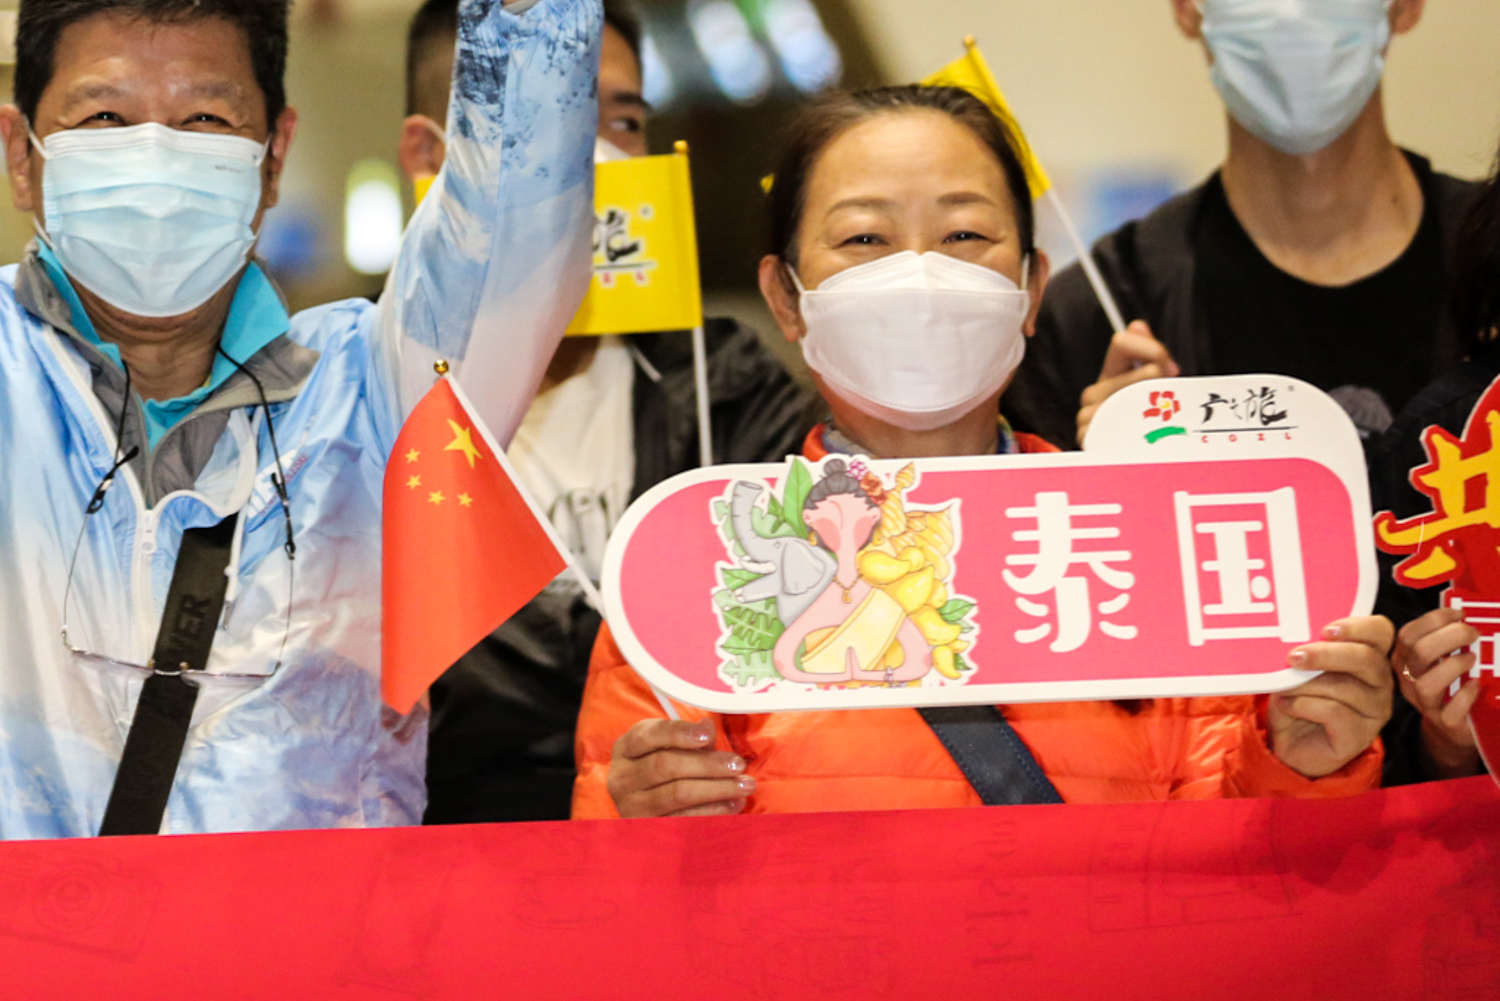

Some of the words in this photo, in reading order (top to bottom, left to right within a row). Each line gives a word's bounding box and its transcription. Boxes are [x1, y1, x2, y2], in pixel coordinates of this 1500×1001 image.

[1200, 386, 1288, 425] 广之旅
[1002, 486, 1311, 653] 泰国
